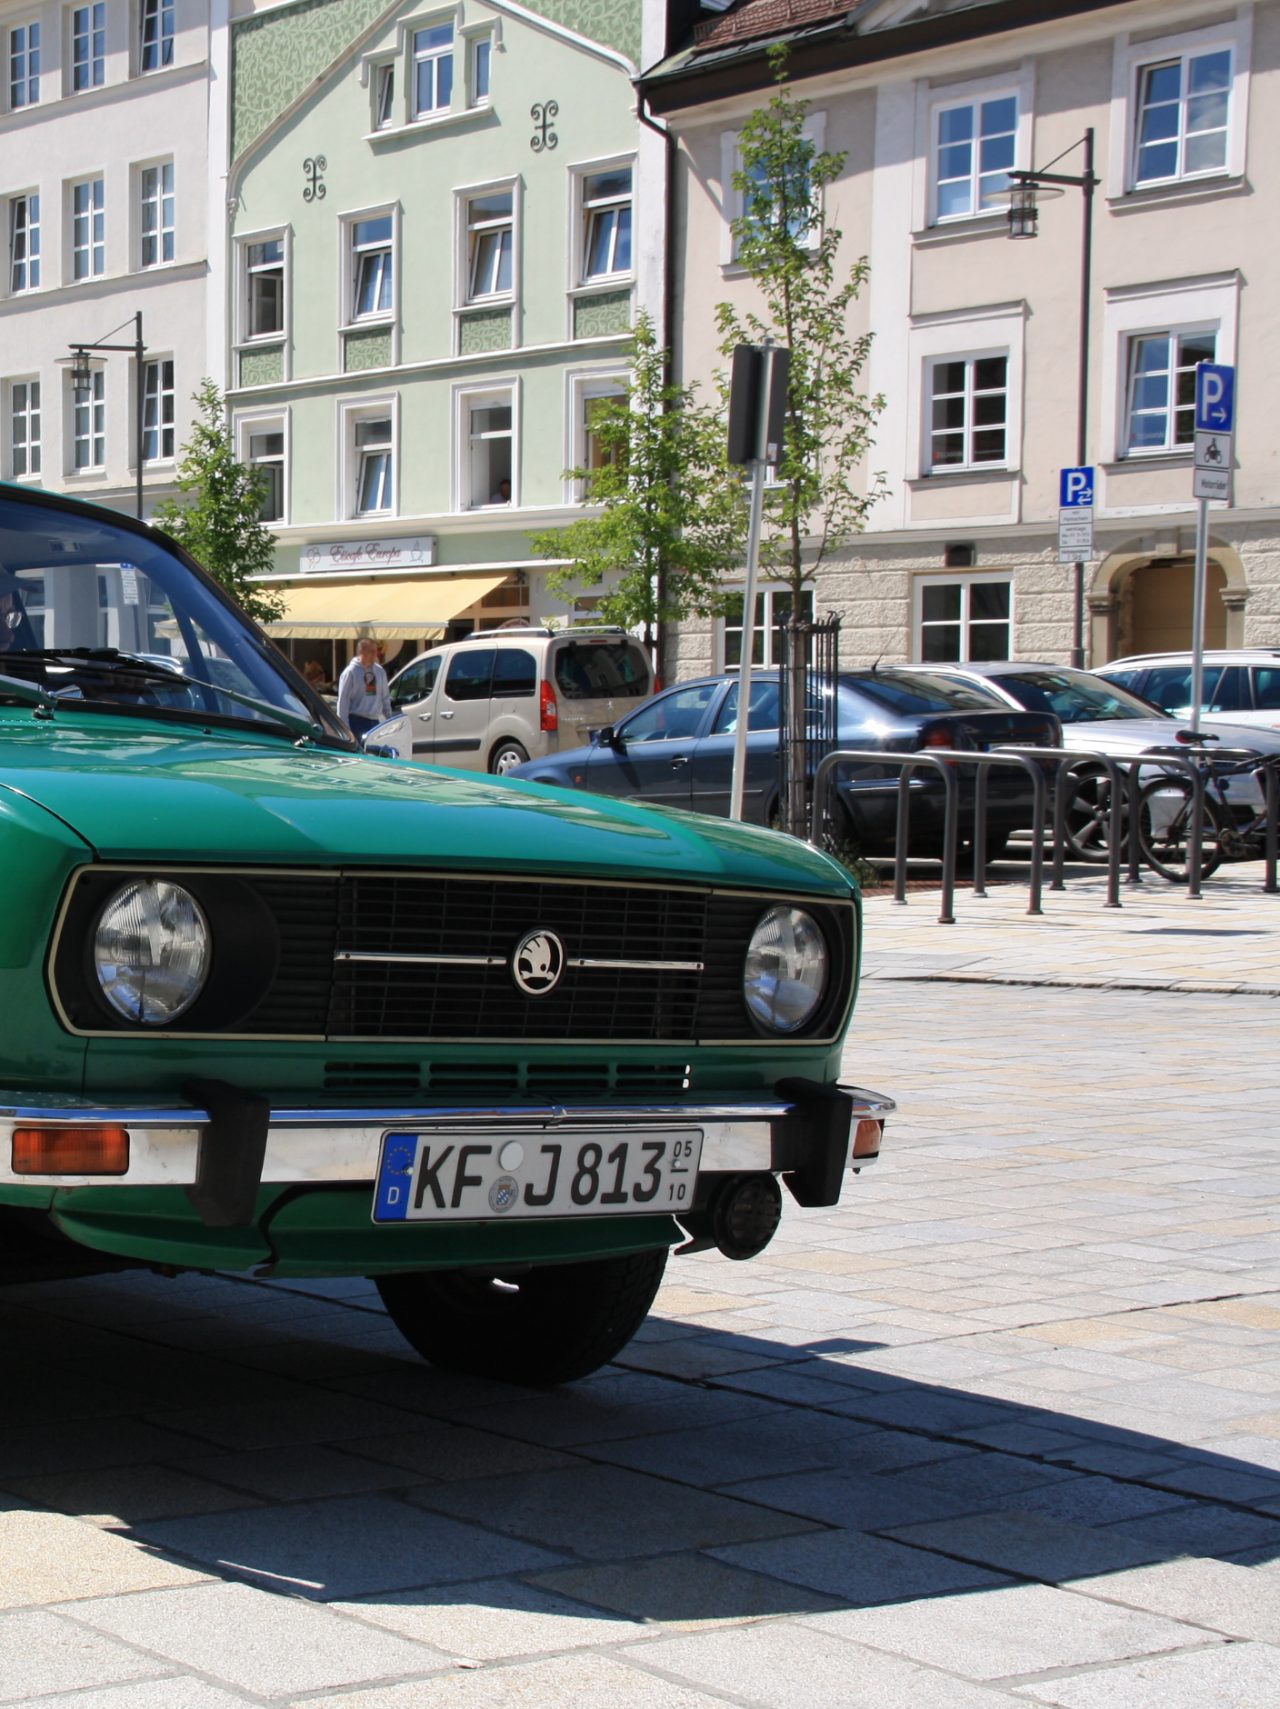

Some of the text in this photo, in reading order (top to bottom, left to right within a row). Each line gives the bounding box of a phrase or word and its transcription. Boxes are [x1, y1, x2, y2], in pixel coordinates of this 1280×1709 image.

[1202, 373, 1223, 422] P
[1067, 472, 1086, 503] P
[673, 1140, 693, 1158] 05
[414, 1141, 667, 1209] KF J 813
[387, 1186, 400, 1205] D
[669, 1183, 687, 1201] 10
